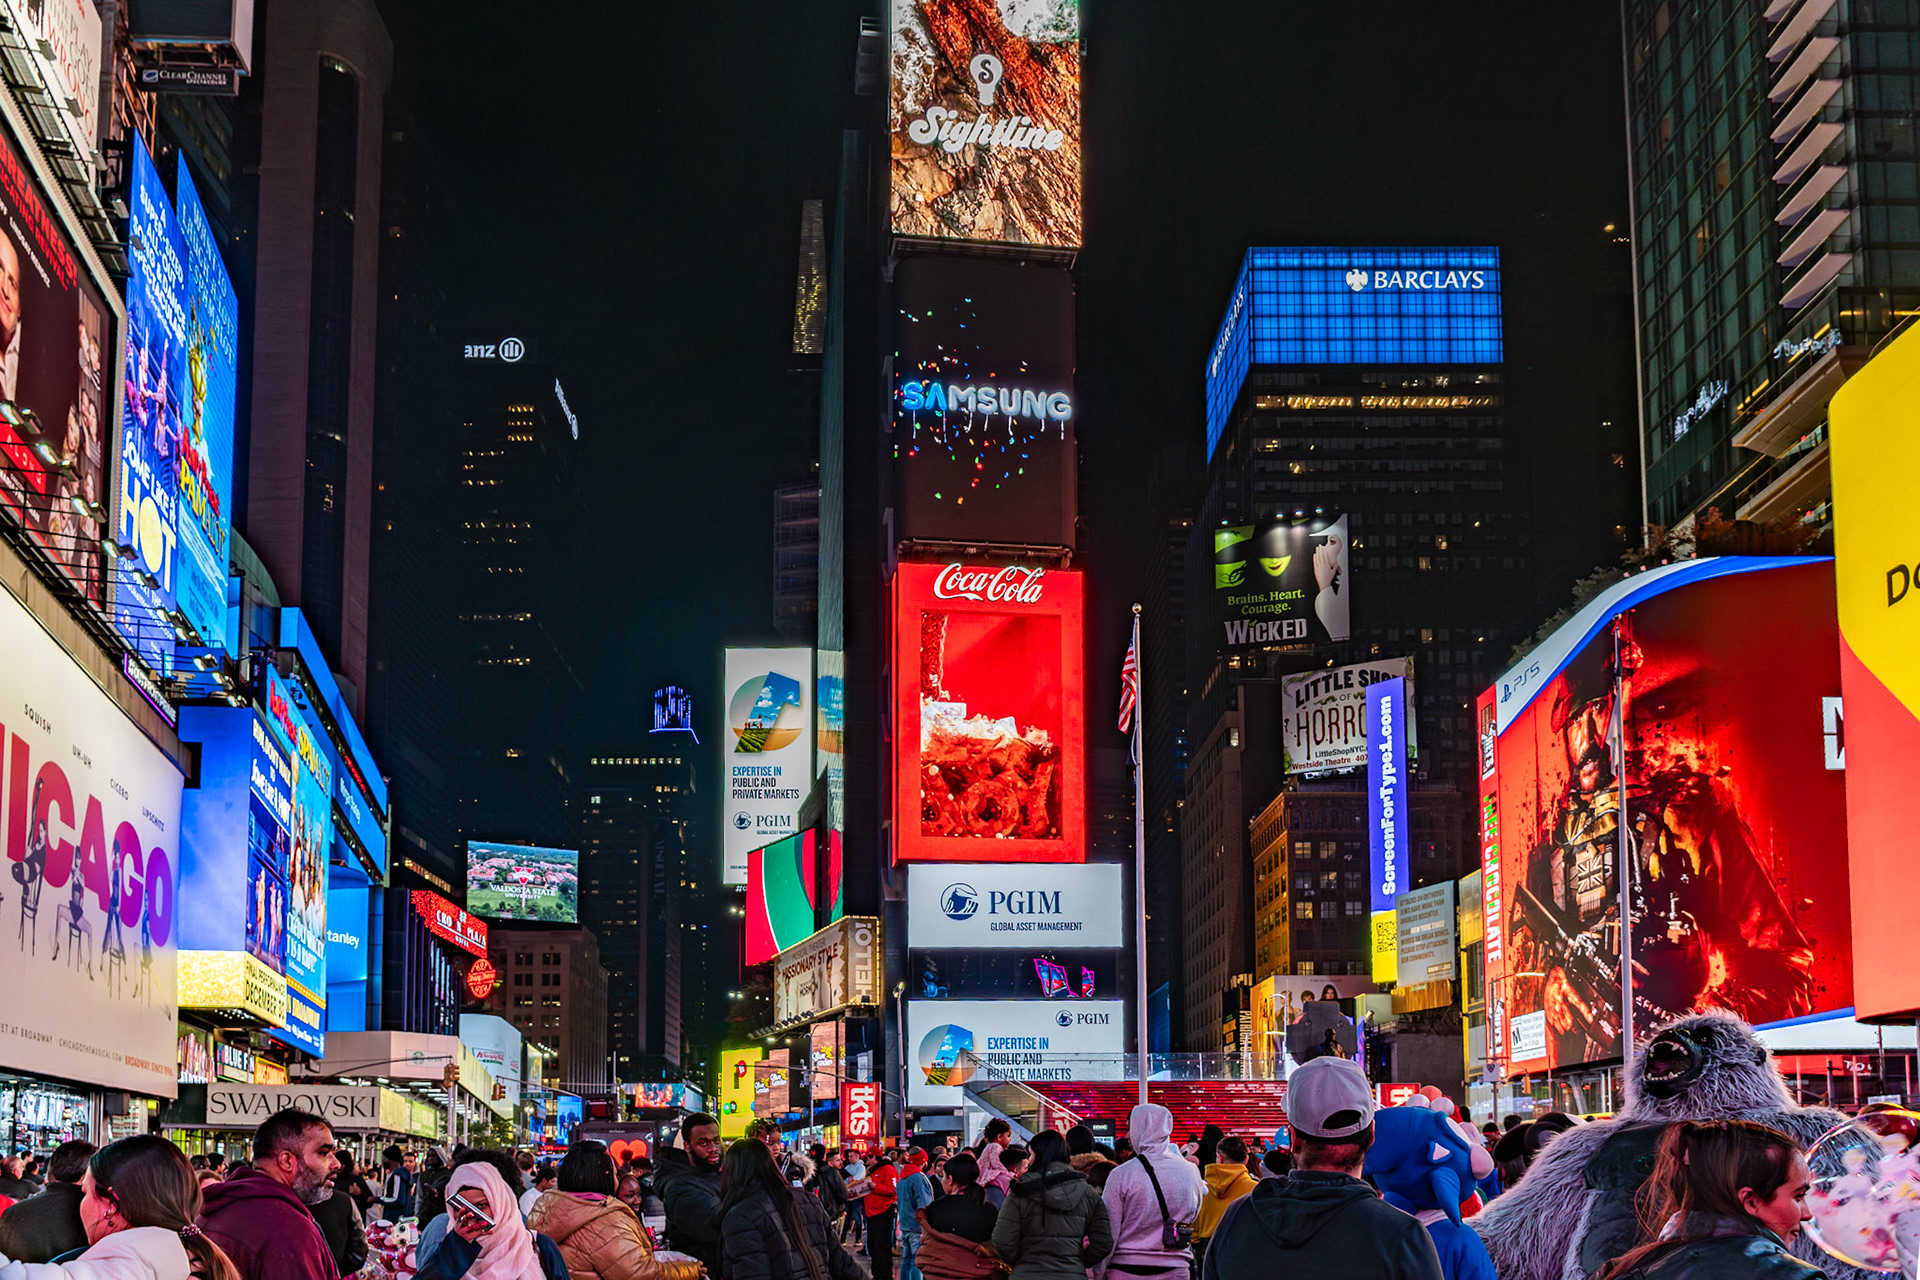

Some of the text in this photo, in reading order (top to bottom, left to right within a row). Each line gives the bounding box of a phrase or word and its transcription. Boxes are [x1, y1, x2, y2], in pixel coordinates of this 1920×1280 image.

[48, 14, 94, 137] WRONG
[908, 106, 1064, 153] Sightline
[147, 222, 177, 290] ALL-OUT
[1373, 270, 1485, 290] BARCLAYS
[902, 381, 1073, 421] SAMSUNG
[119, 458, 178, 593] HOT
[933, 562, 1046, 603] Coca-Cola
[1227, 588, 1305, 606] Brains. Heart.
[1241, 602, 1292, 615] Courage.
[1295, 668, 1399, 709] LITTLE SHO
[24, 703, 52, 735] SQUISH
[72, 744, 93, 769] UH-UH
[1292, 761, 1323, 771] Westside
[1325, 757, 1351, 767] Theatre
[732, 766, 782, 776] EXPERTISE IN
[732, 777, 776, 788] PUBLIC AND
[109, 777, 129, 801] CICERO
[732, 789, 800, 799] PRIVATE MARKETS
[1378, 695, 1397, 896] ScreenForType1.com
[142, 805, 165, 832] LIPSCHITZ
[756, 814, 791, 827] PGIM
[1483, 790, 1499, 843] FREE
[490, 882, 556, 897] VALDOSTA STATE
[504, 892, 541, 900] UNIVERSITY
[987, 890, 1063, 915] PGIM
[1484, 842, 1502, 964] CHOCOLATE
[990, 921, 1083, 932] GLOBAL ASSET MANAGEMENT
[782, 942, 839, 982] MISSIONARY STYLE
[854, 921, 873, 1003] HELLO!
[245, 979, 277, 1017] DECEMBER
[1076, 1013, 1109, 1025] PGIM
[11, 1026, 19, 1036] AT
[20, 1028, 53, 1044] BROADWAY
[151, 1062, 164, 1074] SINCE
[812, 1051, 826, 1060] Olive
[987, 1037, 1049, 1050] EXPERTISE IN
[223, 1044, 243, 1070] BLUE
[987, 1053, 1042, 1065] PUBLIC AND
[769, 1073, 781, 1081] Olive
[987, 1068, 1072, 1080] PRIVATE MARKETS
[210, 1091, 377, 1118] SWAROVSKI
[850, 1085, 875, 1136] tkts
